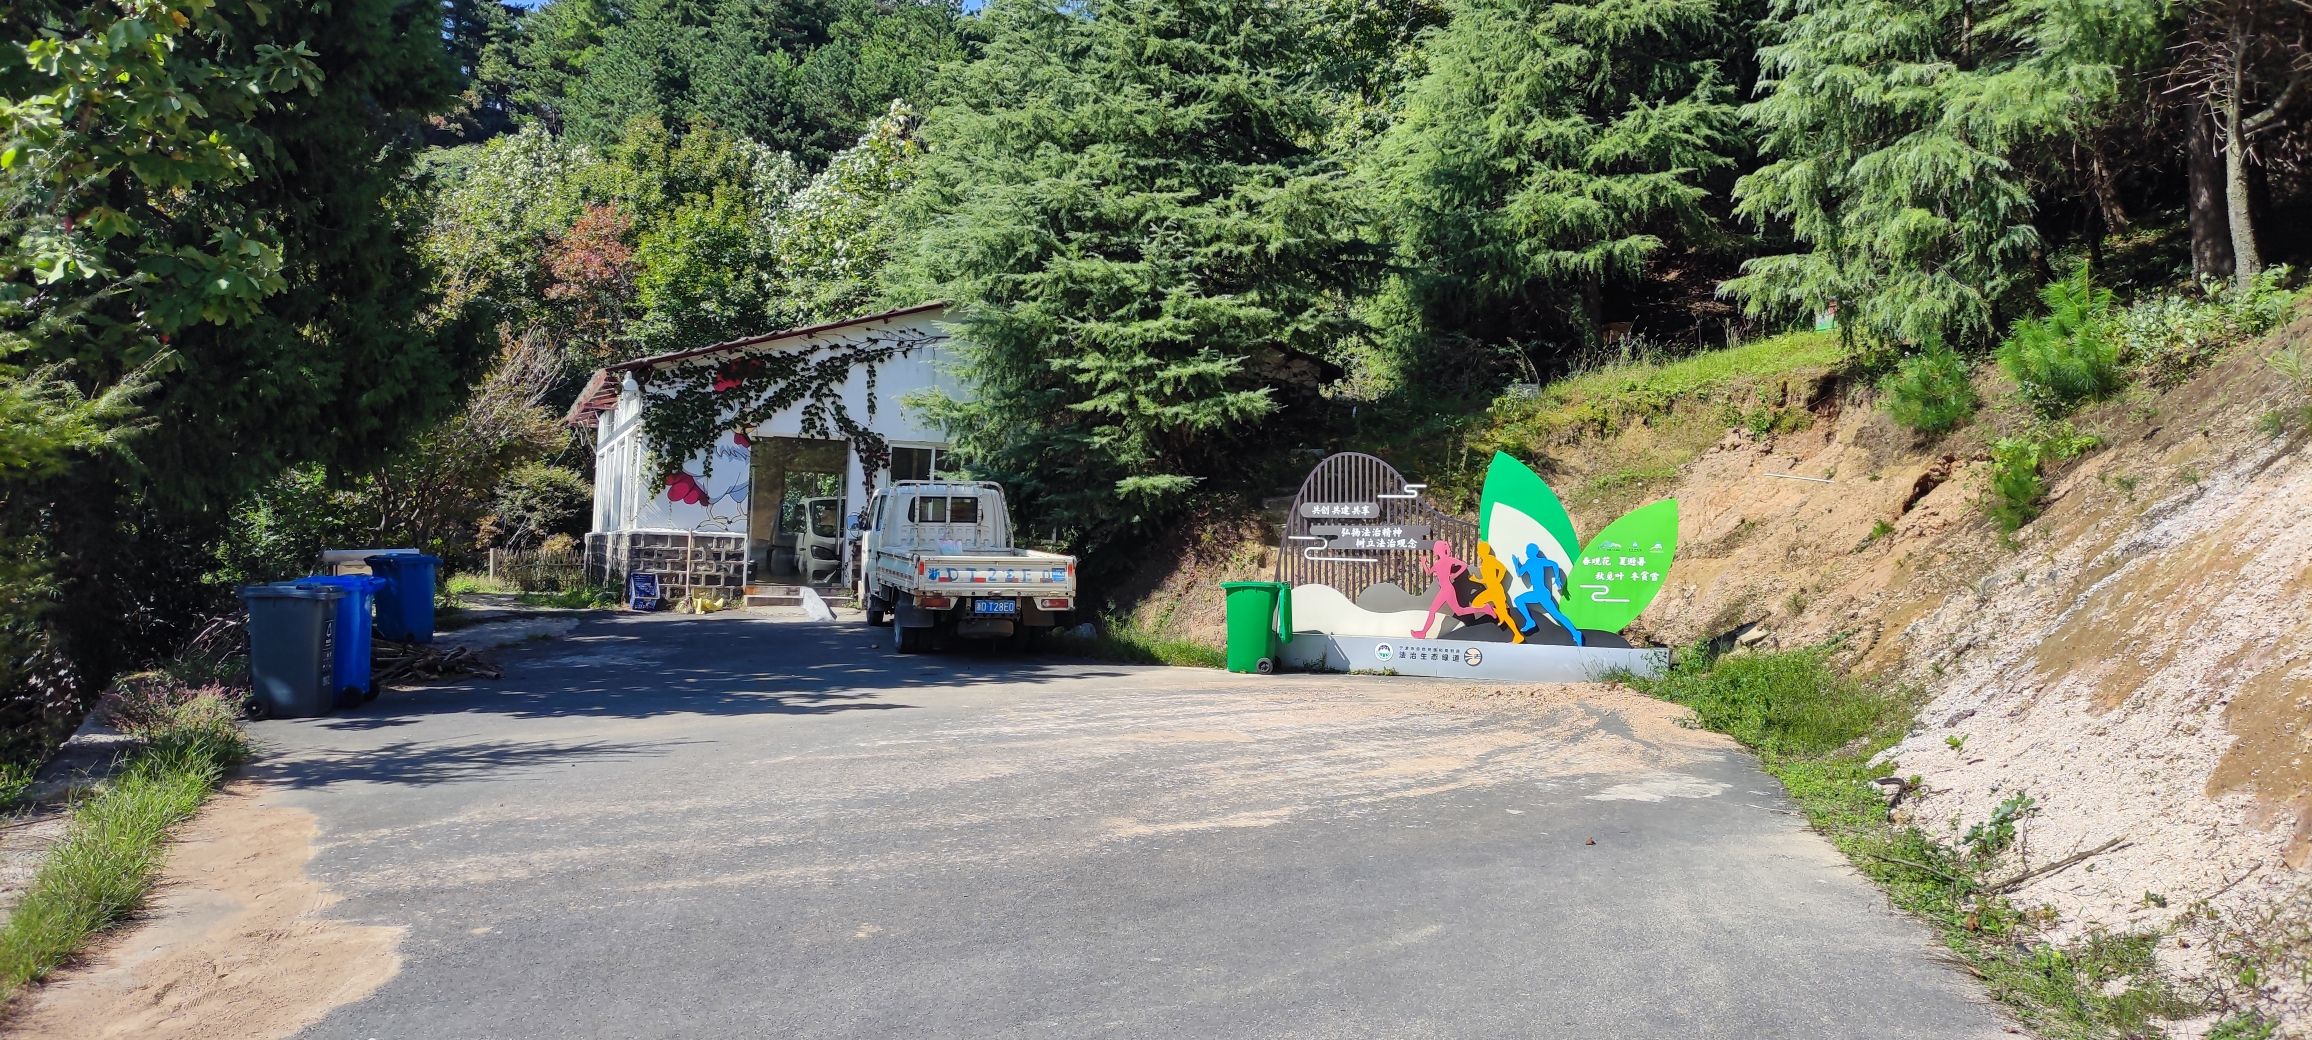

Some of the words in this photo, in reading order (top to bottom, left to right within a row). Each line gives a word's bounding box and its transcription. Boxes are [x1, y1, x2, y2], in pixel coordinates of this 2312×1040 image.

[1312, 505, 1330, 515] 共创
[1331, 505, 1351, 515] 共建
[1351, 505, 1371, 516] 共享
[1341, 527, 1403, 538] 弘扬法治精神
[1355, 538, 1418, 549] 树立法治观念
[1399, 651, 1460, 663] 法治生态绿道
